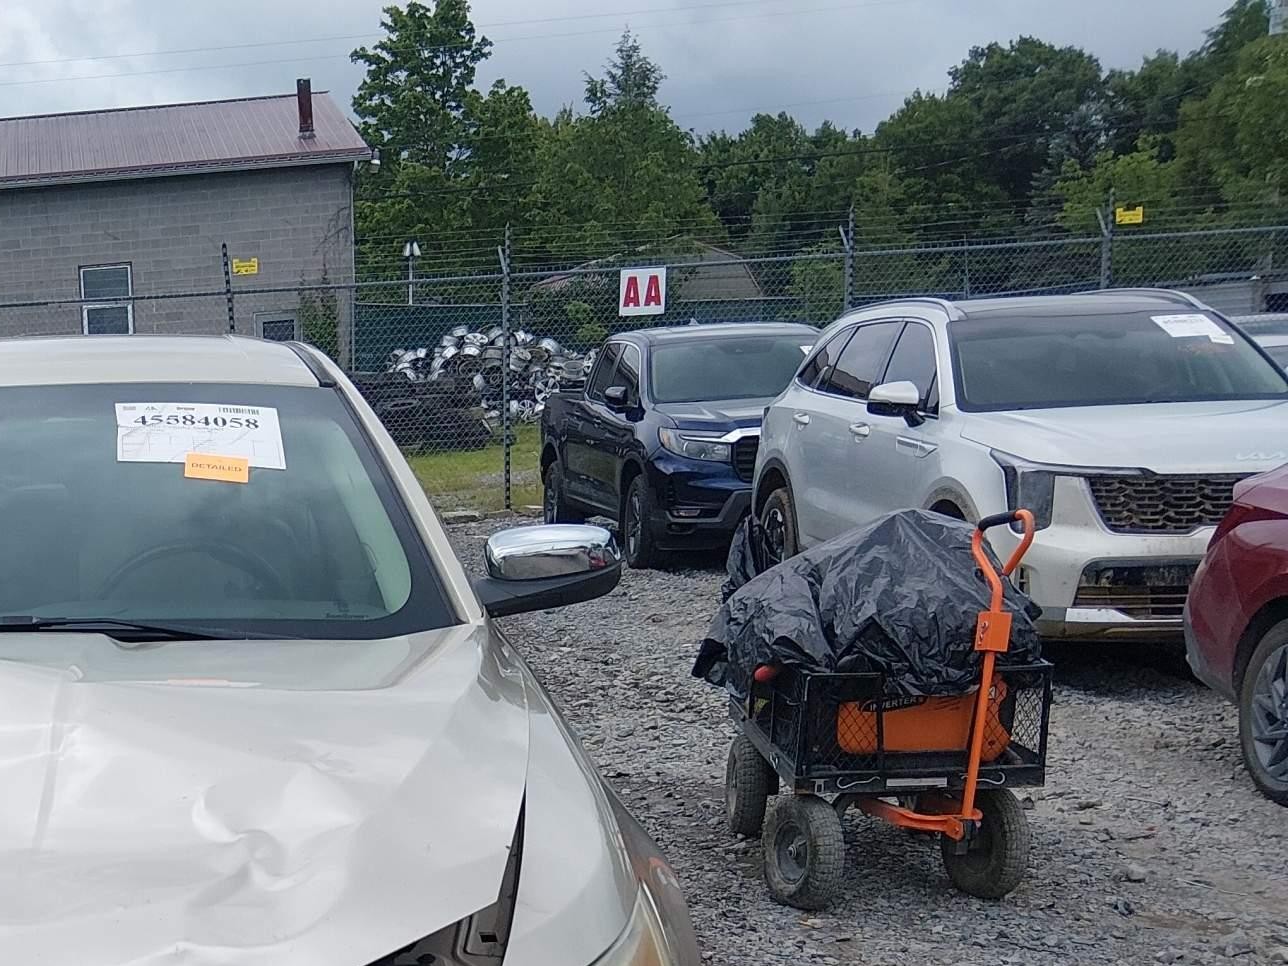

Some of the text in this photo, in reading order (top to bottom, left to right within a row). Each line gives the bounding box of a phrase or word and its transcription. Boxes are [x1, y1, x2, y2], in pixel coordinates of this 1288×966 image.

[622, 274, 662, 308] AA
[133, 414, 260, 430] 45584058
[191, 462, 243, 473] DETAILED
